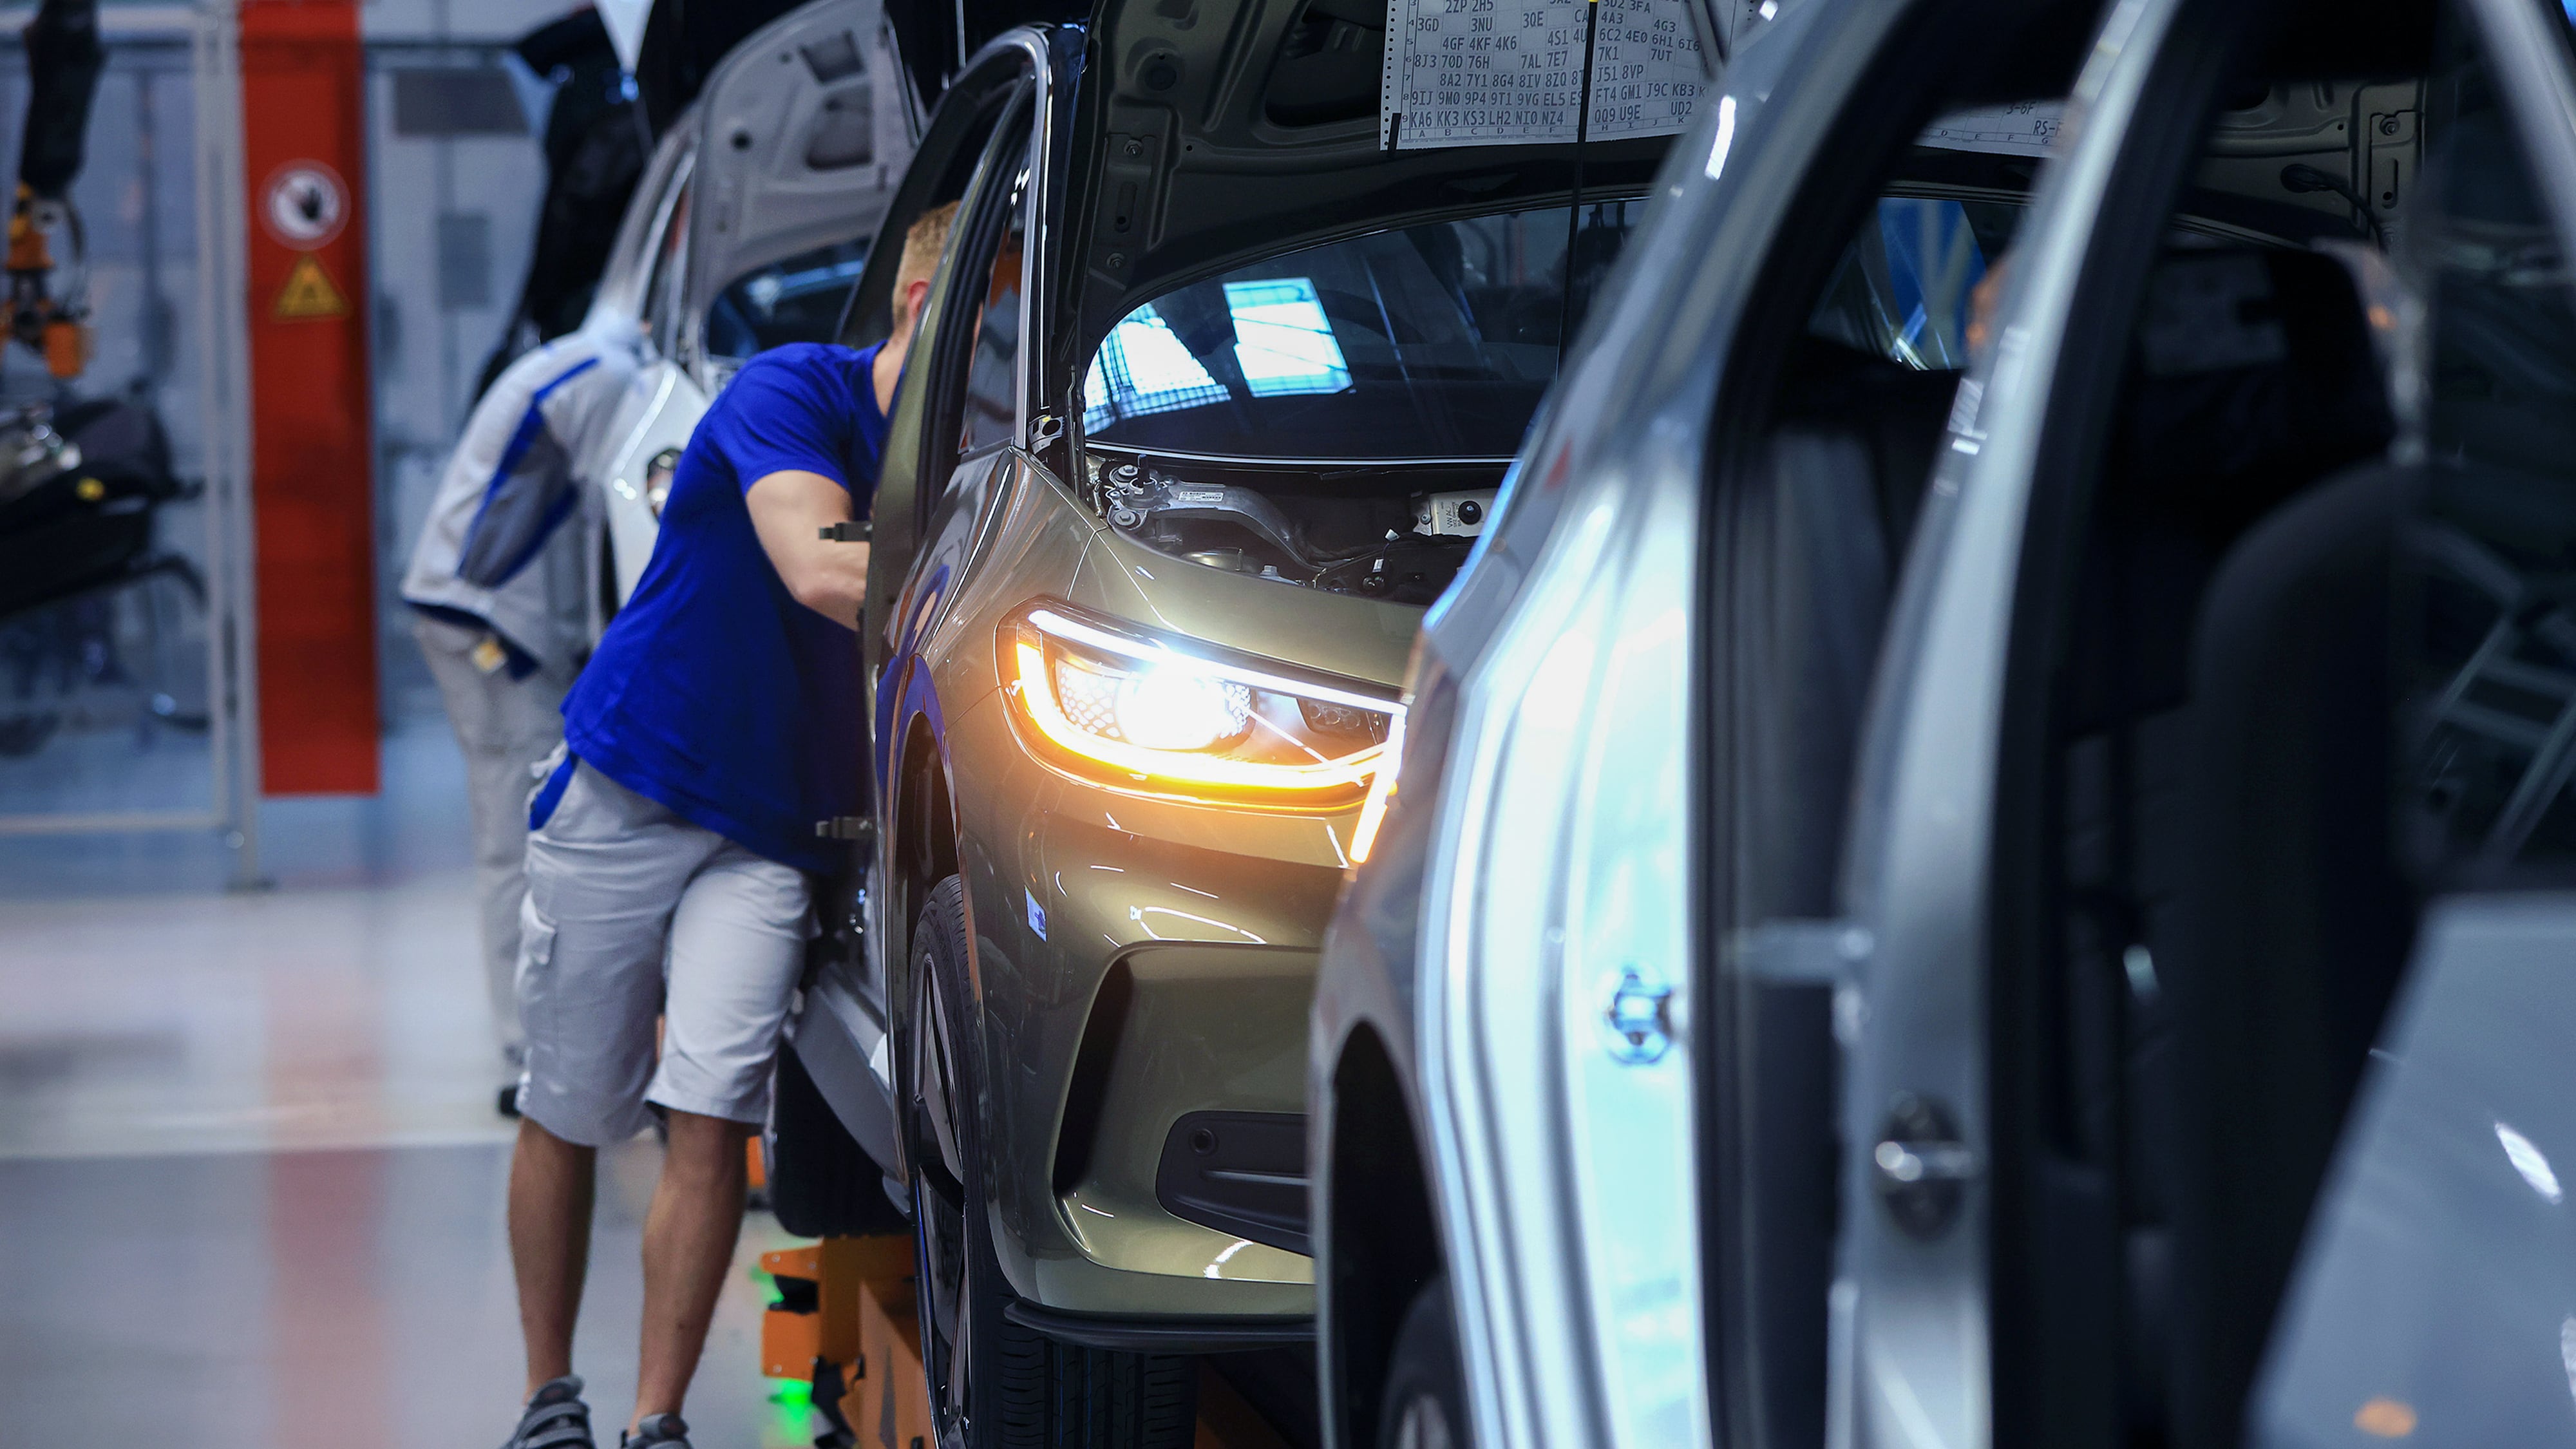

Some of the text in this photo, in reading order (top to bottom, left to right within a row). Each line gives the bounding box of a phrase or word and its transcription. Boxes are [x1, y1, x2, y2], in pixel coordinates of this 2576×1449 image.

[1629, 1, 1651, 14] 3FA
[1418, 17, 1439, 32] 3GD
[1471, 17, 1493, 32] 3NU
[1523, 12, 1544, 28] 3QE
[1601, 12, 1624, 24] 4A3
[1654, 19, 1676, 32] 4G3
[1443, 37, 1464, 50] 4GF
[1470, 37, 1491, 50] 4KF
[1495, 36, 1517, 50] 4K6
[1548, 30, 1568, 46] 4S1
[1599, 28, 1621, 41] 6C2
[1625, 30, 1647, 43] 4E0
[1652, 34, 1673, 48] 6H1
[1678, 39, 1700, 51] 6I6
[1415, 55, 1437, 68] 8J3
[1442, 55, 1463, 68] 70D
[1468, 55, 1490, 69] 76H
[1521, 53, 1541, 69] 7AL
[1547, 50, 1567, 68] 7E7
[1598, 46, 1619, 62] 7K1
[1651, 48, 1672, 62] 7UT
[1439, 73, 1461, 86] 8A2
[1467, 73, 1488, 87] 7Y1
[1492, 74, 1513, 88] 8G4
[1519, 74, 1540, 88] 8IV
[1546, 72, 1567, 87] 8ZQ
[1597, 66, 1617, 82] J51
[1622, 64, 1643, 79] 8VP
[1412, 91, 1433, 106] 9IJ
[1438, 91, 1460, 106] 9M0
[1465, 92, 1486, 106] 9P4
[1492, 92, 1511, 106] 9T1
[1518, 93, 1539, 106] 9VG
[1544, 93, 1565, 106] EL5
[1596, 86, 1616, 103] FT4
[1621, 84, 1642, 100] GM1
[1646, 83, 1668, 97] J9C
[1672, 83, 1694, 96] KB3
[1411, 111, 1432, 128] KA6
[1437, 111, 1459, 126] KK3
[1463, 111, 1485, 126] KS3
[1489, 111, 1511, 125] LH2
[1516, 111, 1537, 125] NI0
[1542, 111, 1564, 125] NZ4
[1595, 108, 1615, 123] QQ9
[1620, 104, 1641, 121] U9E
[1671, 101, 1692, 115] UD2
